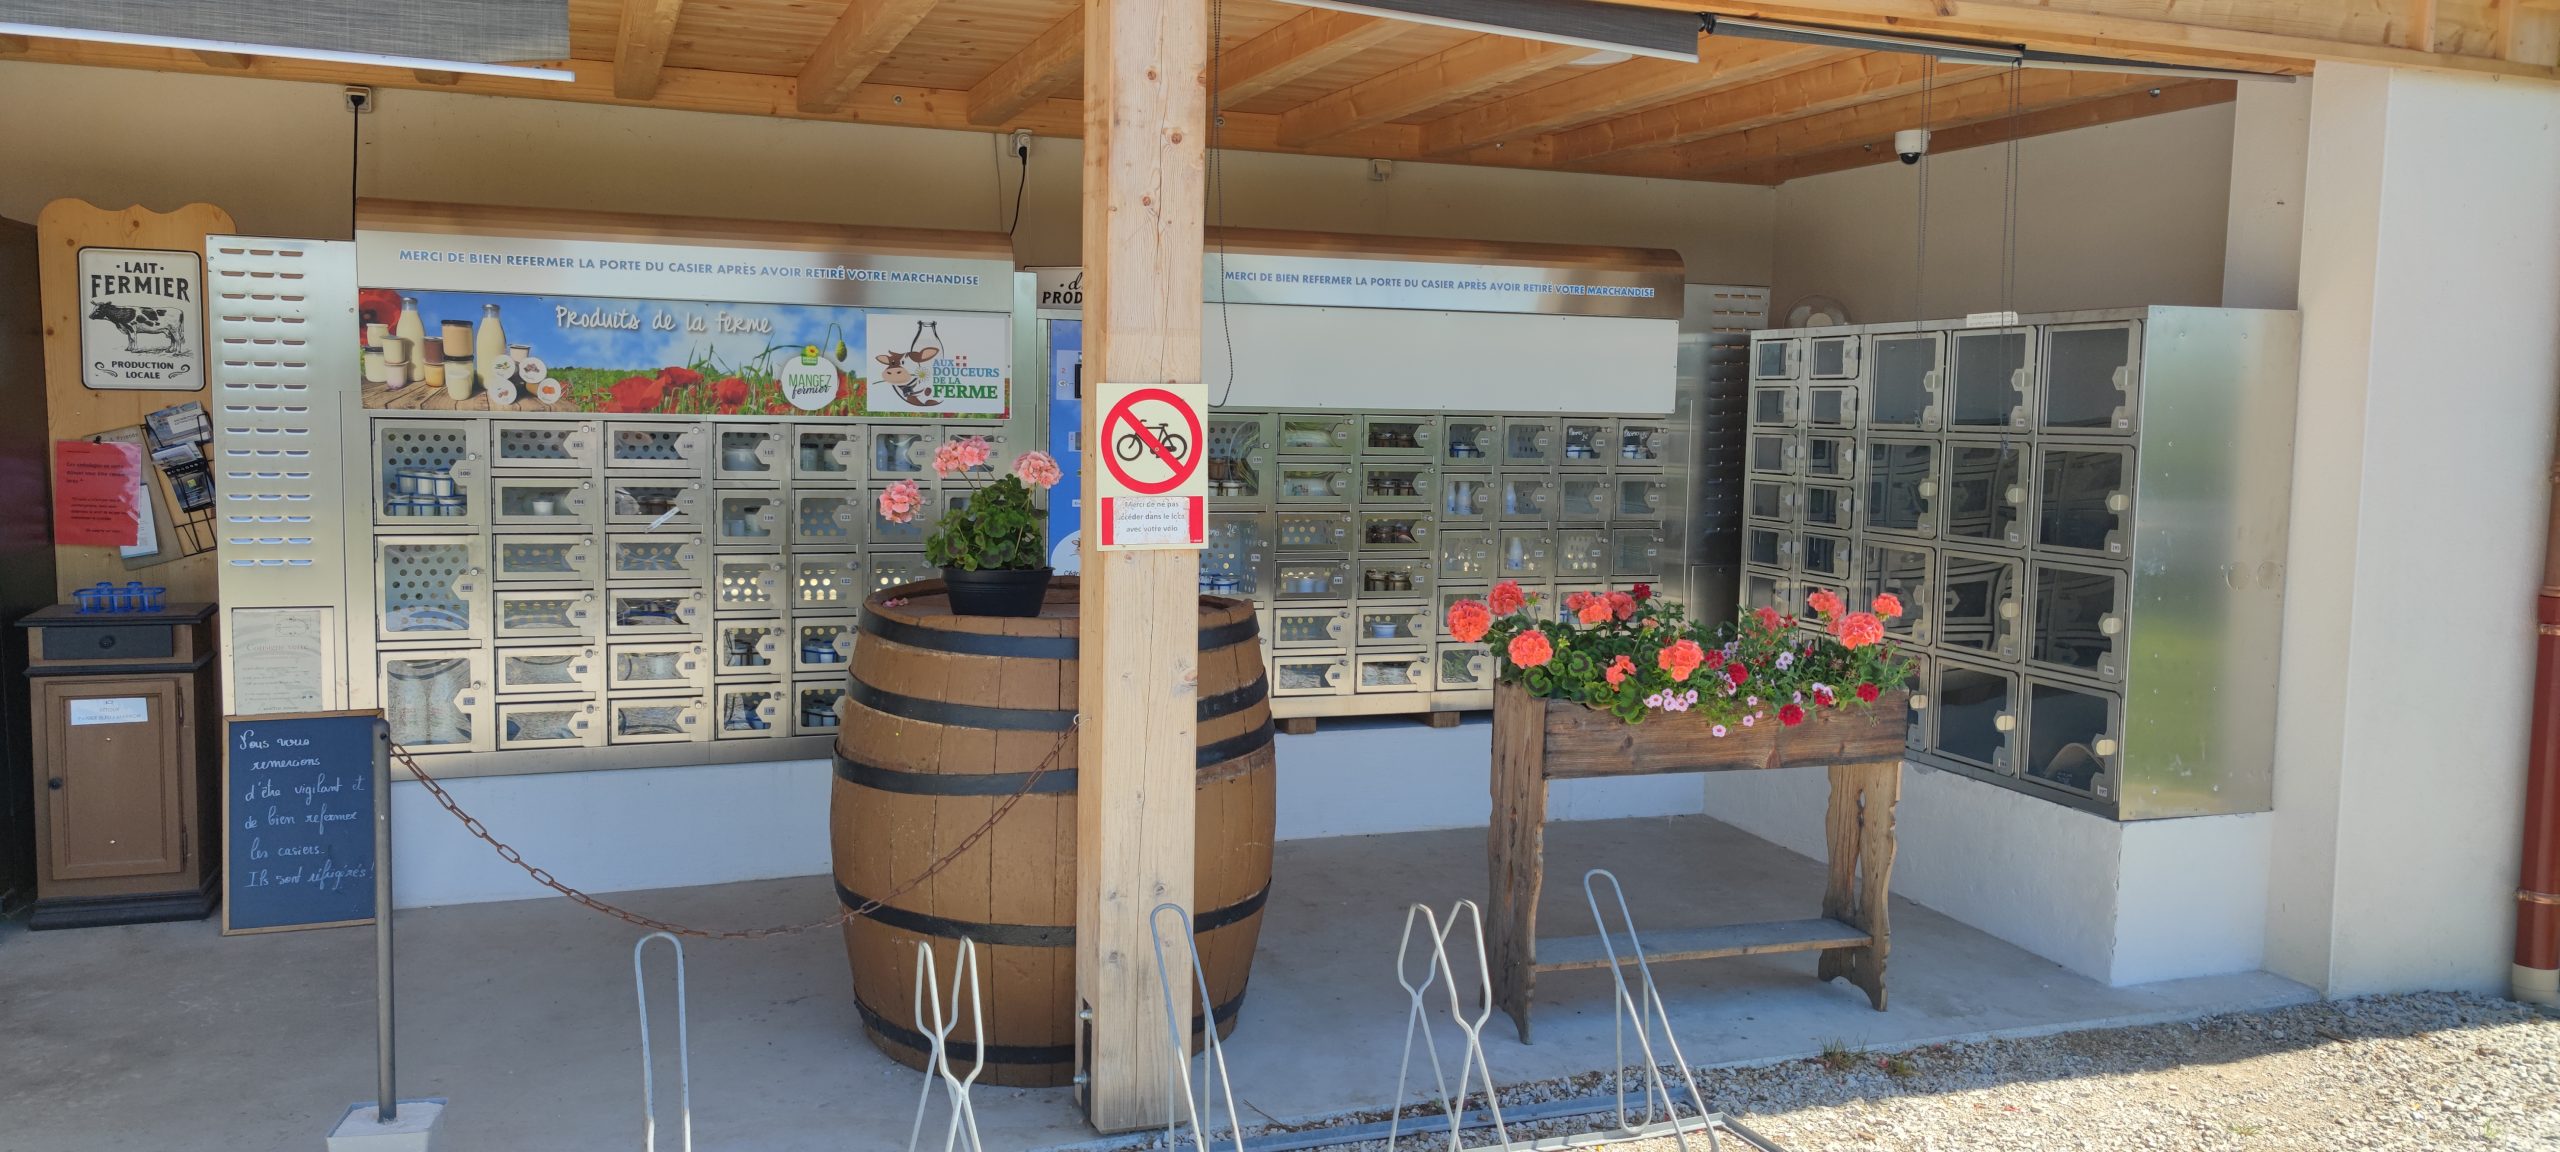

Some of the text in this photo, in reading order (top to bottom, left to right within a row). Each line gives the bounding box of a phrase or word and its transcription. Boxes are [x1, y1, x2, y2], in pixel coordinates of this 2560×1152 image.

[125, 262, 158, 274] LAIT
[400, 250, 979, 286] MERCI DE BIEN REFERMER LA PORTE DU CASIER APRÈS AVOIR RETIRÉ VOTRE MARCHANDISE
[91, 274, 190, 303] FERMIER
[1225, 272, 1654, 297] MERCI DE BIEN REFERMER LA PORTE DU CASIER APRÈS AVOIR RETIRÉ VOTRE MARCHANDISE
[555, 304, 772, 334] Produits de la ferme
[112, 361, 174, 369] PRODUCTION
[933, 368, 1000, 377] DOUCEURS
[788, 375, 832, 388] MANGEZ
[792, 384, 830, 400] fermier
[933, 384, 998, 399] FERME
[277, 738, 310, 747] vous
[250, 758, 320, 771] remercions
[245, 773, 365, 806] d'être vigilant et
[245, 803, 358, 835] de bien refermer
[250, 837, 268, 860] les
[244, 869, 269, 887] Ils
[276, 866, 303, 885] sont
